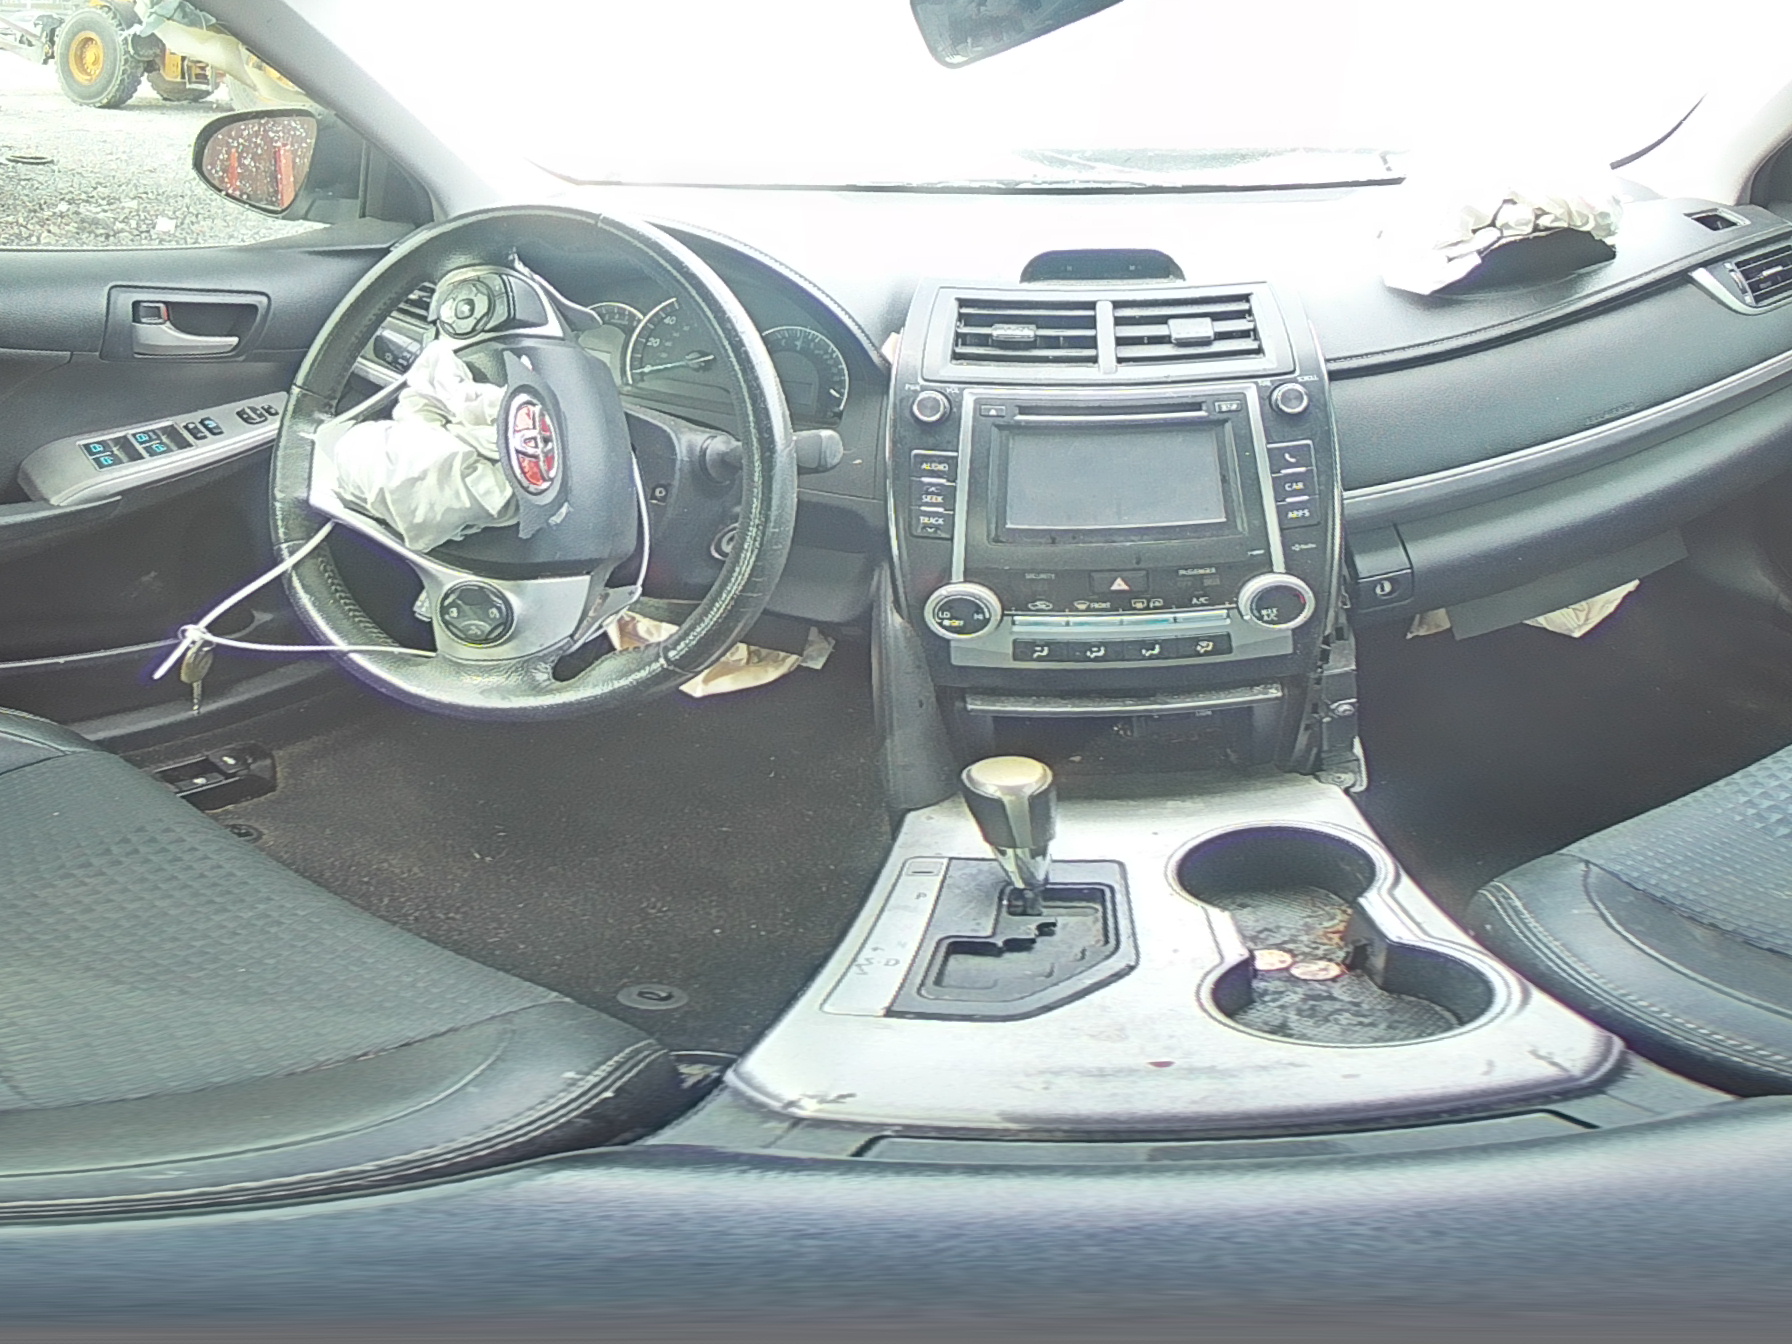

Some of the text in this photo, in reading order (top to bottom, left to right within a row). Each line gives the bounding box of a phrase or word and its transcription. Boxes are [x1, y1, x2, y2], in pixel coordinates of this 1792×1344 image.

[663, 316, 677, 325] 40
[646, 338, 661, 347] 20
[921, 462, 949, 471] AUDIO
[1285, 482, 1304, 491] CAR
[921, 495, 945, 503] SEEK
[1287, 509, 1310, 518] APPS
[919, 516, 945, 524] TRACK
